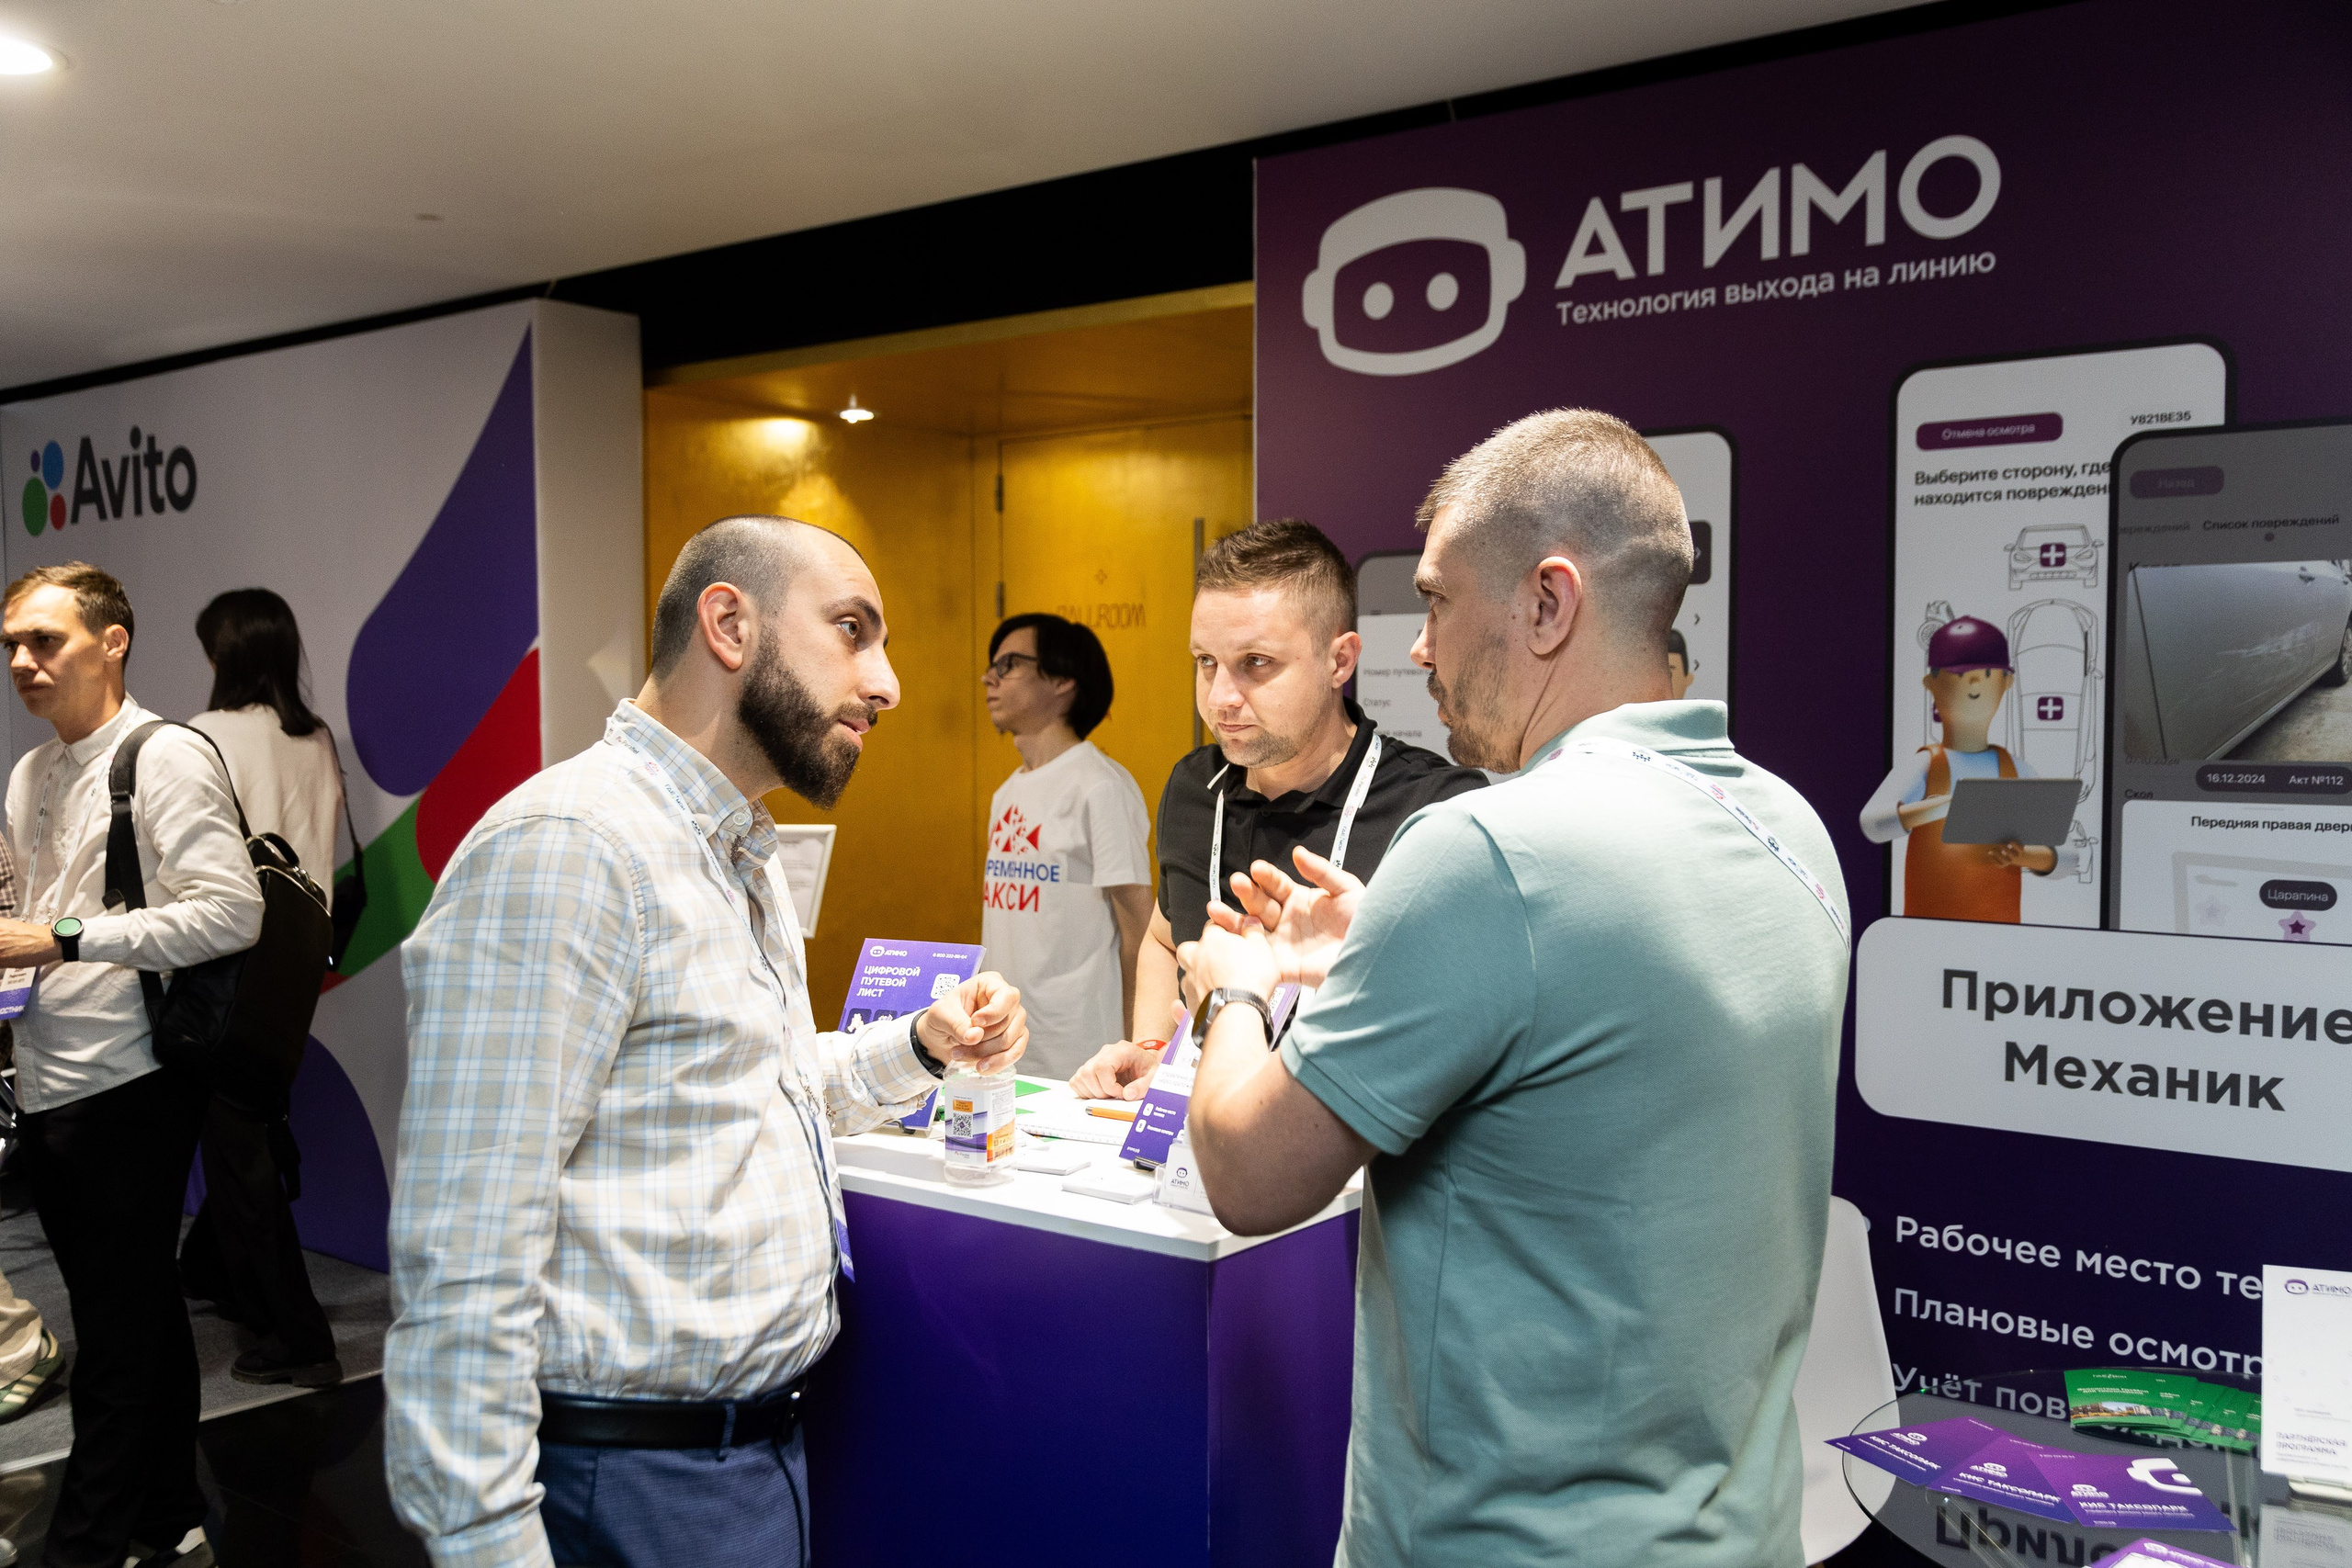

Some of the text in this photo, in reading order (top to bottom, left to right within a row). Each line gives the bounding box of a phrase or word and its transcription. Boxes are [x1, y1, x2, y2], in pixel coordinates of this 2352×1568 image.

[1555, 134, 2002, 289] АТИМО
[1556, 251, 1997, 326] Технология выхода на линию
[1941, 423, 2036, 441] Отмена осмотра
[71, 425, 197, 525] Avito
[1915, 461, 2111, 486] Выберите сторону, где
[1914, 482, 2110, 507] находится поврежден
[2202, 519, 2248, 531] Список
[2252, 514, 2340, 529] повреждений
[2207, 773, 2344, 786] 16.12.2024 Акт №112
[2191, 816, 2352, 834] Передняя правая двер
[986, 859, 1060, 883] РЕМЕННОЕ
[982, 881, 1040, 912] АКСИ
[2267, 888, 2329, 904] Царапина
[884, 949, 908, 957] АТИМО
[860, 976, 907, 988] ПУТЕВОЙ
[864, 965, 921, 977] ЦИФРОВОЙ
[856, 987, 885, 998] ЛИСТ
[1941, 967, 2352, 1045] Приложение
[2004, 1040, 2287, 1112] Механик
[1894, 1214, 2263, 1301] Рабочее место те
[1894, 1286, 2263, 1380] Плановые осмотр
[1893, 1361, 2067, 1421] Учёт пов
